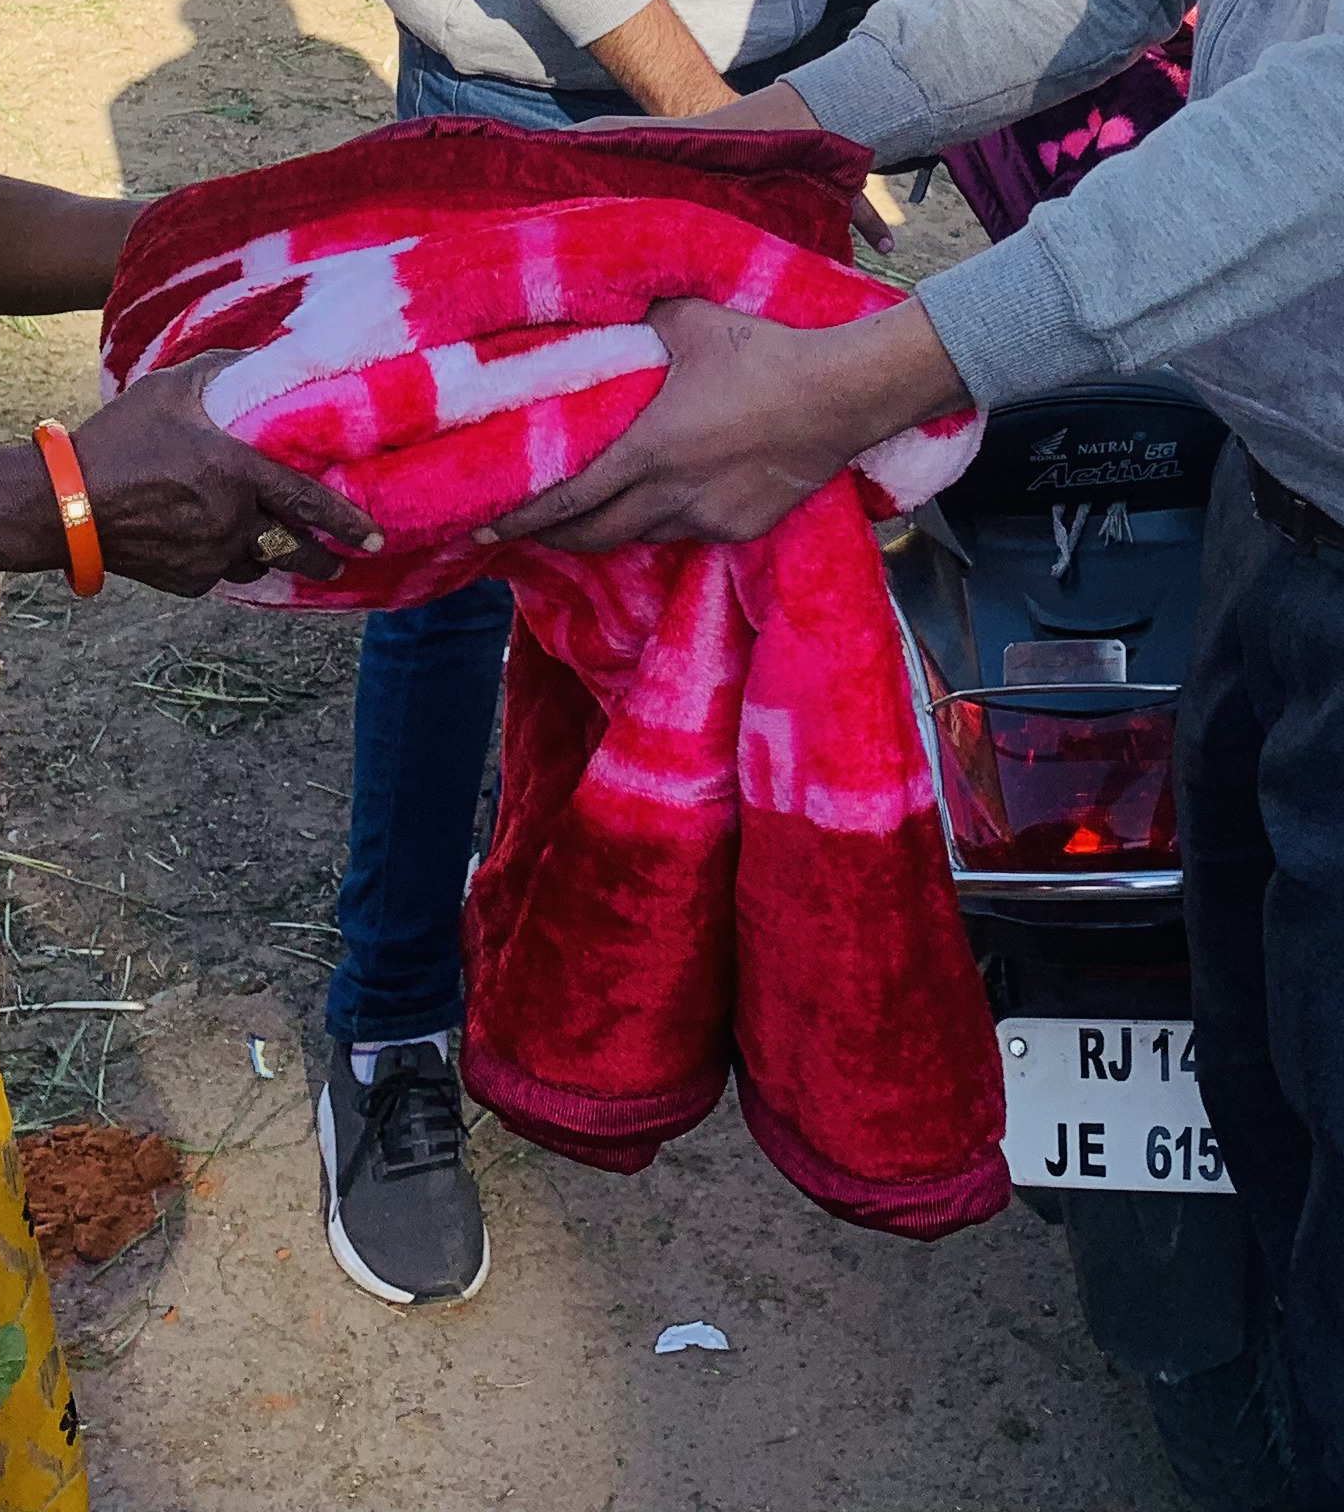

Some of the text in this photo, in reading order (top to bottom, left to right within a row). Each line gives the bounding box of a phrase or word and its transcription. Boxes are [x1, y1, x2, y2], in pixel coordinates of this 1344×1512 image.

[1077, 439, 1135, 456] NATRAJ
[1144, 441, 1177, 461] 5G
[1026, 459, 1184, 491] Activa
[1078, 1027, 1133, 1081] RJ
[1044, 1122, 1106, 1177] JE
